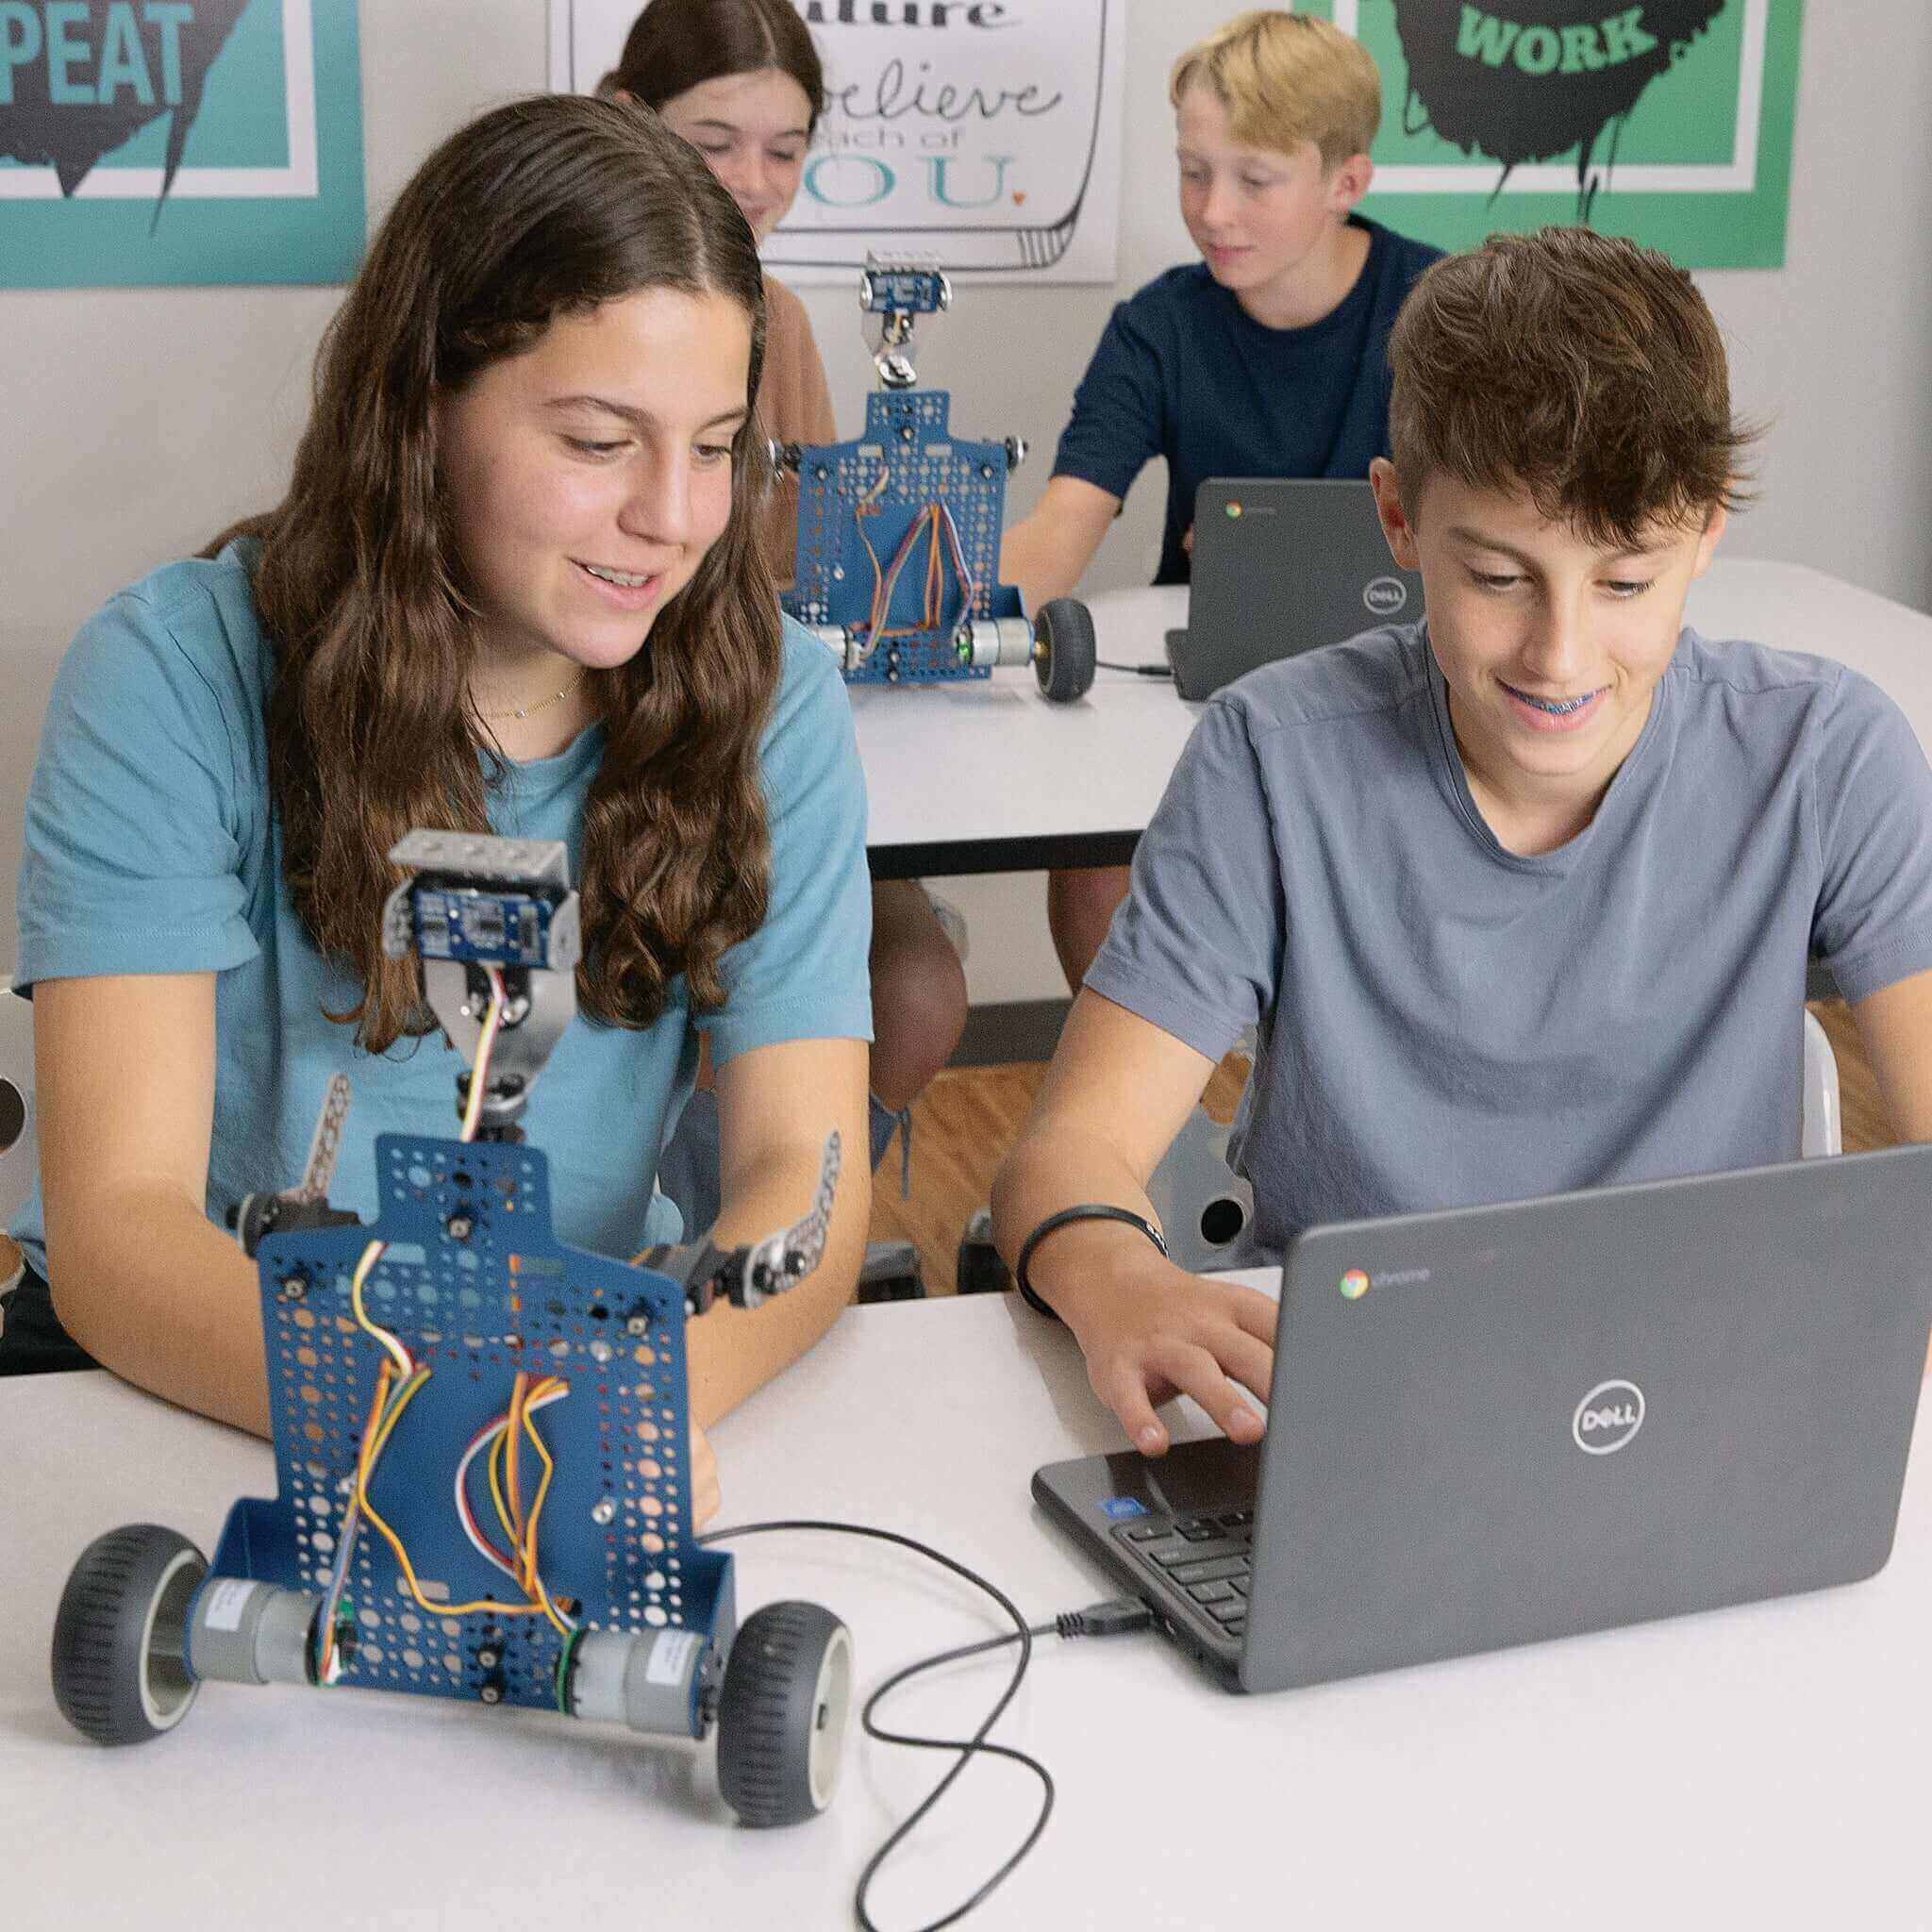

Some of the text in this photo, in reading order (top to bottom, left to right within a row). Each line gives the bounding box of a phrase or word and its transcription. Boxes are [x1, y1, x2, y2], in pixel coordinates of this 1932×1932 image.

[0, 0, 196, 106] PEAT
[1456, 5, 1657, 75] WORK
[817, 126, 905, 148] ach
[803, 154, 1014, 209] OU
[1582, 1403, 1637, 1431] DELL
